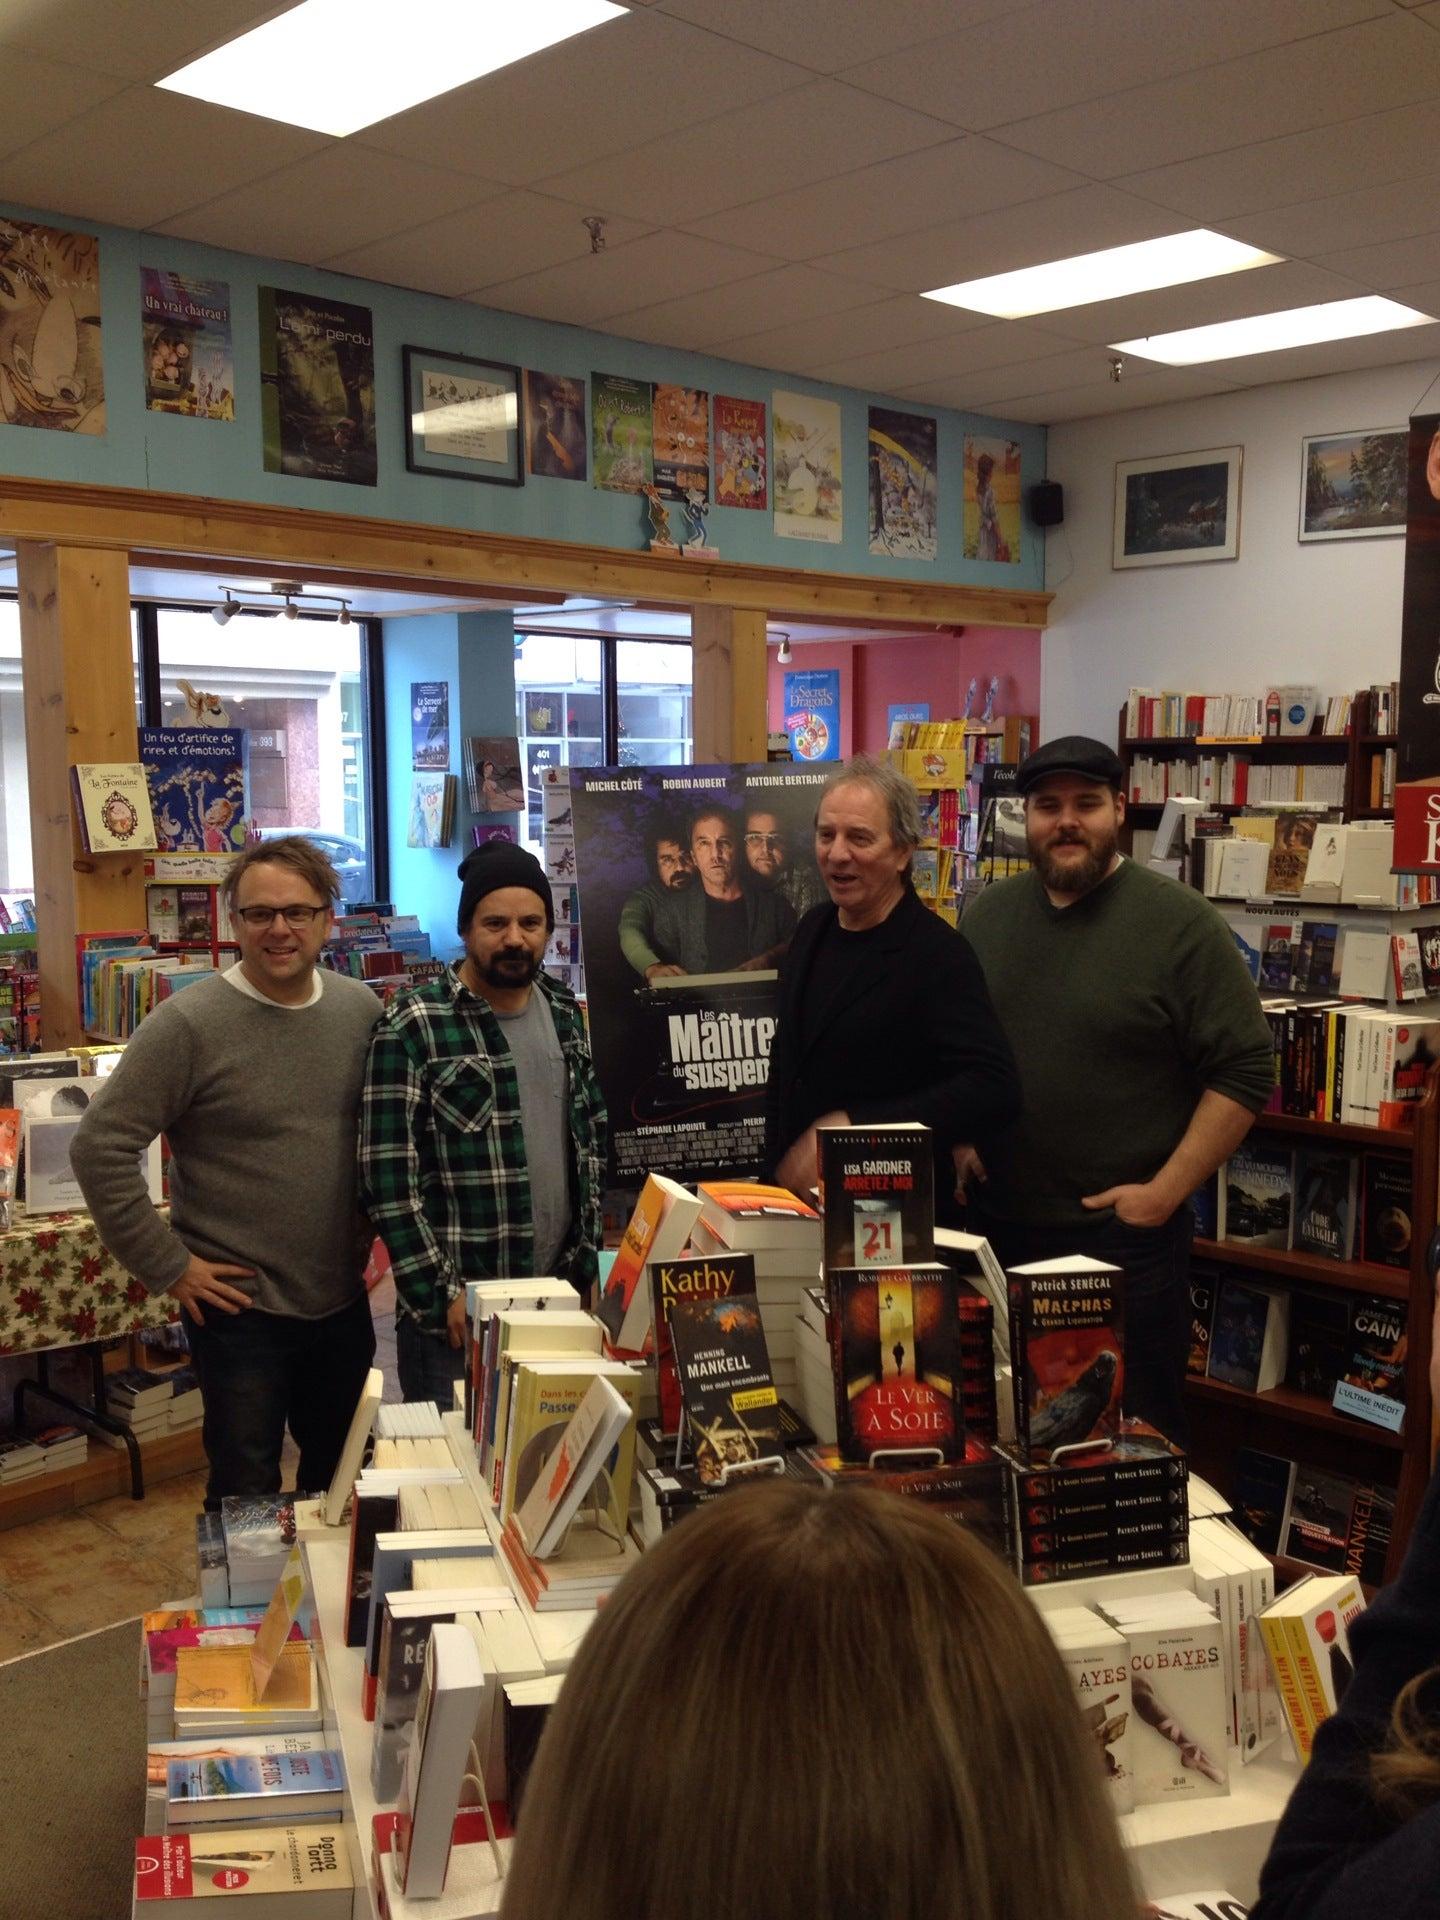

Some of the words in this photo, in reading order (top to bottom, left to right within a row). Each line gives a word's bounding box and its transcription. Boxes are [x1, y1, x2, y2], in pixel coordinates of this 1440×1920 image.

[146, 296, 160, 310] Un
[162, 300, 182, 313] vrai
[326, 329, 371, 346] perdu
[799, 685, 828, 697] Secret
[790, 694, 833, 708] Dragons
[144, 733, 157, 743] Un
[160, 733, 174, 743] feu
[177, 732, 219, 743] d'artifice
[222, 733, 234, 743] de
[143, 746, 166, 756] rires
[169, 746, 178, 755] et
[181, 744, 236, 756] d'émotions!
[536, 750, 550, 759] 401
[103, 777, 138, 788] Fontaine
[585, 781, 621, 792] MICHEL
[621, 777, 643, 791] CÔTÉ
[663, 779, 692, 790] ROBIN
[692, 777, 726, 789] AUBERT
[746, 775, 785, 787] ANTOINE
[700, 1009, 715, 1022] Les
[668, 1012, 778, 1063] Maître
[673, 1065, 685, 1078] du
[685, 1057, 770, 1092] suspen
[637, 1125, 672, 1136] STÉPHANE
[673, 1121, 706, 1133] LAPOINTE
[844, 1164, 861, 1175] LISA
[862, 1160, 912, 1175] GARDNER
[862, 1221, 892, 1250] 21
[661, 1263, 735, 1298] Kathy
[858, 1272, 889, 1283] ROBERT
[893, 1272, 942, 1282] GALBRAITH
[1070, 1275, 1112, 1291] SENÉCAL
[1032, 1297, 1113, 1315] MALPHAS
[1354, 1316, 1401, 1342] CAIN
[694, 1348, 725, 1361] HENNING
[687, 1355, 751, 1379] MANKELL
[700, 1383, 714, 1393] Une
[714, 1381, 731, 1390] main
[731, 1374, 770, 1387] encombrante
[541, 1390, 562, 1398] Dans
[564, 1389, 577, 1398] les
[877, 1388, 895, 1405] LE
[899, 1388, 935, 1404] VER
[540, 1401, 576, 1414] Passe
[736, 1396, 773, 1409] Wallander
[1338, 1387, 1372, 1406] L'ULTIME
[1373, 1399, 1401, 1417] INÉDIT
[867, 1408, 882, 1431] À
[890, 1407, 945, 1431] SOIE
[1345, 1487, 1377, 1576] MANKELL
[1131, 1647, 1219, 1672] COBAYES
[1275, 1656, 1287, 1672] FIN
[1298, 1656, 1310, 1672] FIN
[1079, 1666, 1128, 1688] AYES
[1309, 1696, 1328, 1723] EURT
[287, 1837, 302, 1885] chardonneret
[306, 1844, 323, 1873] Tartt
[320, 1836, 337, 1871] Donna
